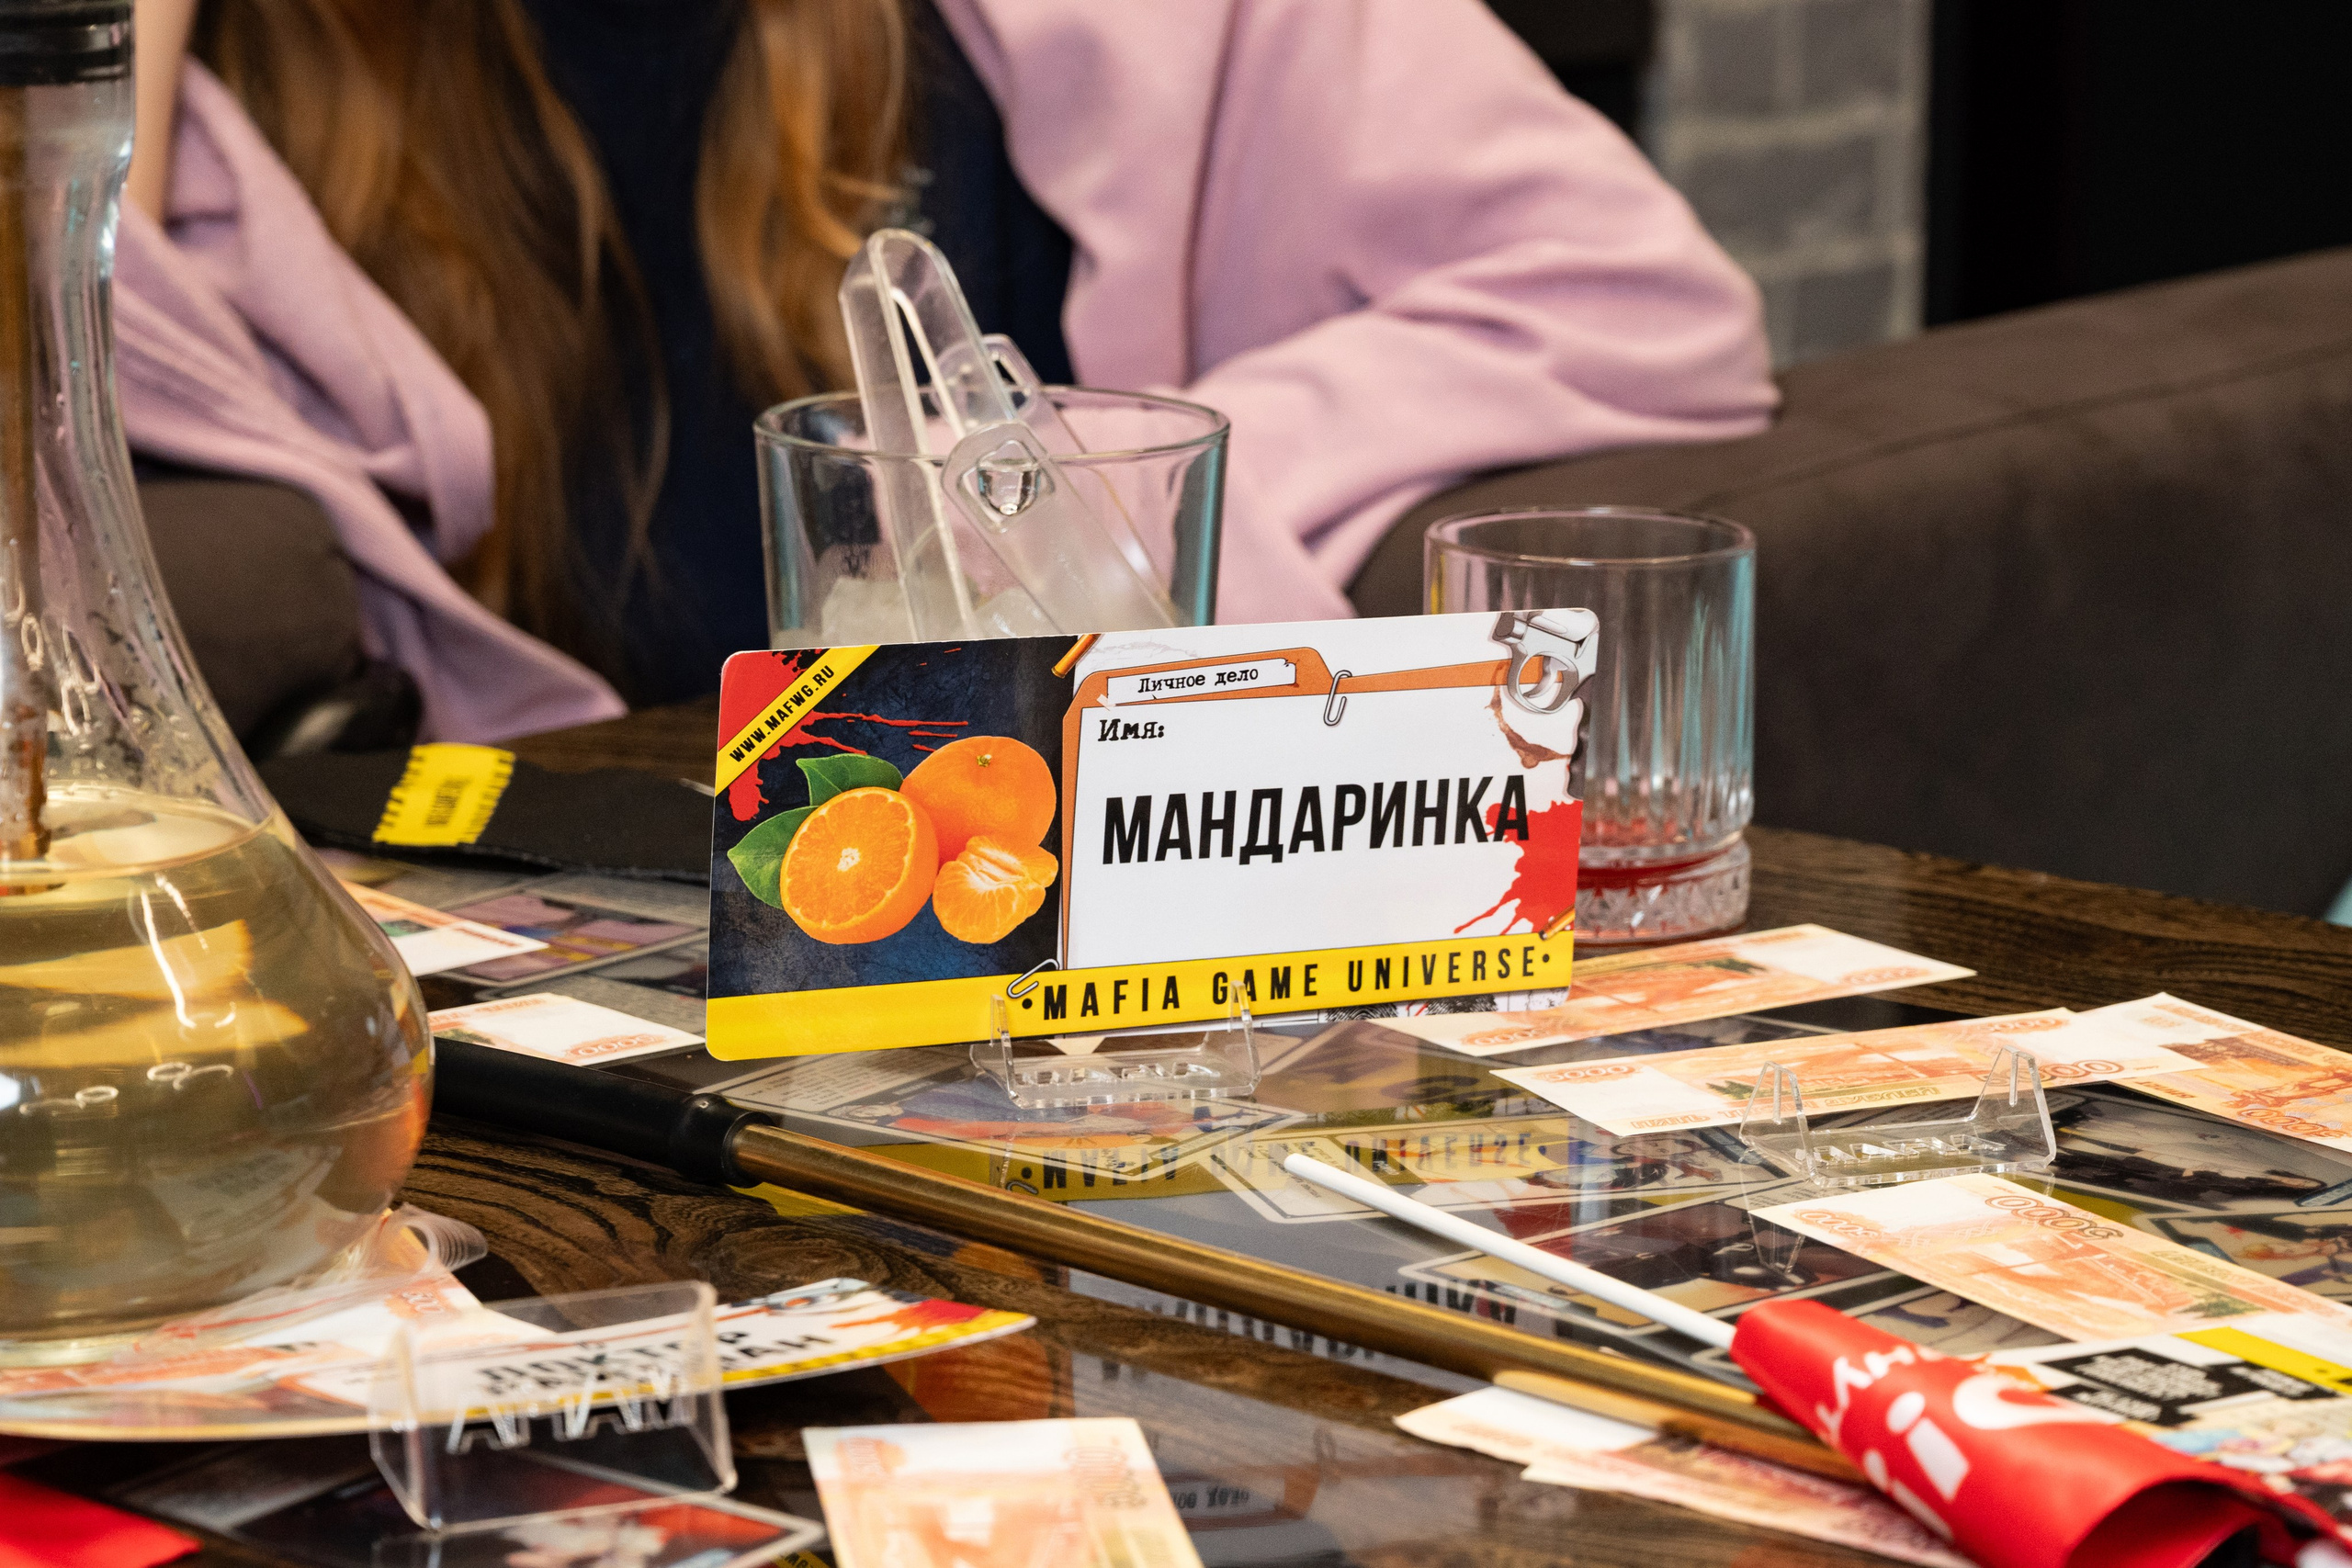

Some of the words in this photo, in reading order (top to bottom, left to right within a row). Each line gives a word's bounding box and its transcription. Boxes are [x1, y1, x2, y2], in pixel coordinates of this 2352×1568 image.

[1137, 673, 1206, 694] Личное
[1214, 668, 1260, 687] дело
[729, 664, 835, 763] WWW.MAFWG.RU
[1097, 717, 1166, 742] Имя:
[1102, 774, 1531, 865] МАНДАРИНКА
[1043, 976, 1181, 1021] MAFIA
[1212, 963, 1318, 1005] GAME
[1347, 945, 1535, 992] UNIVERSE
[1545, 1065, 1632, 1081] 5000
[1984, 1195, 2125, 1241] 5000
